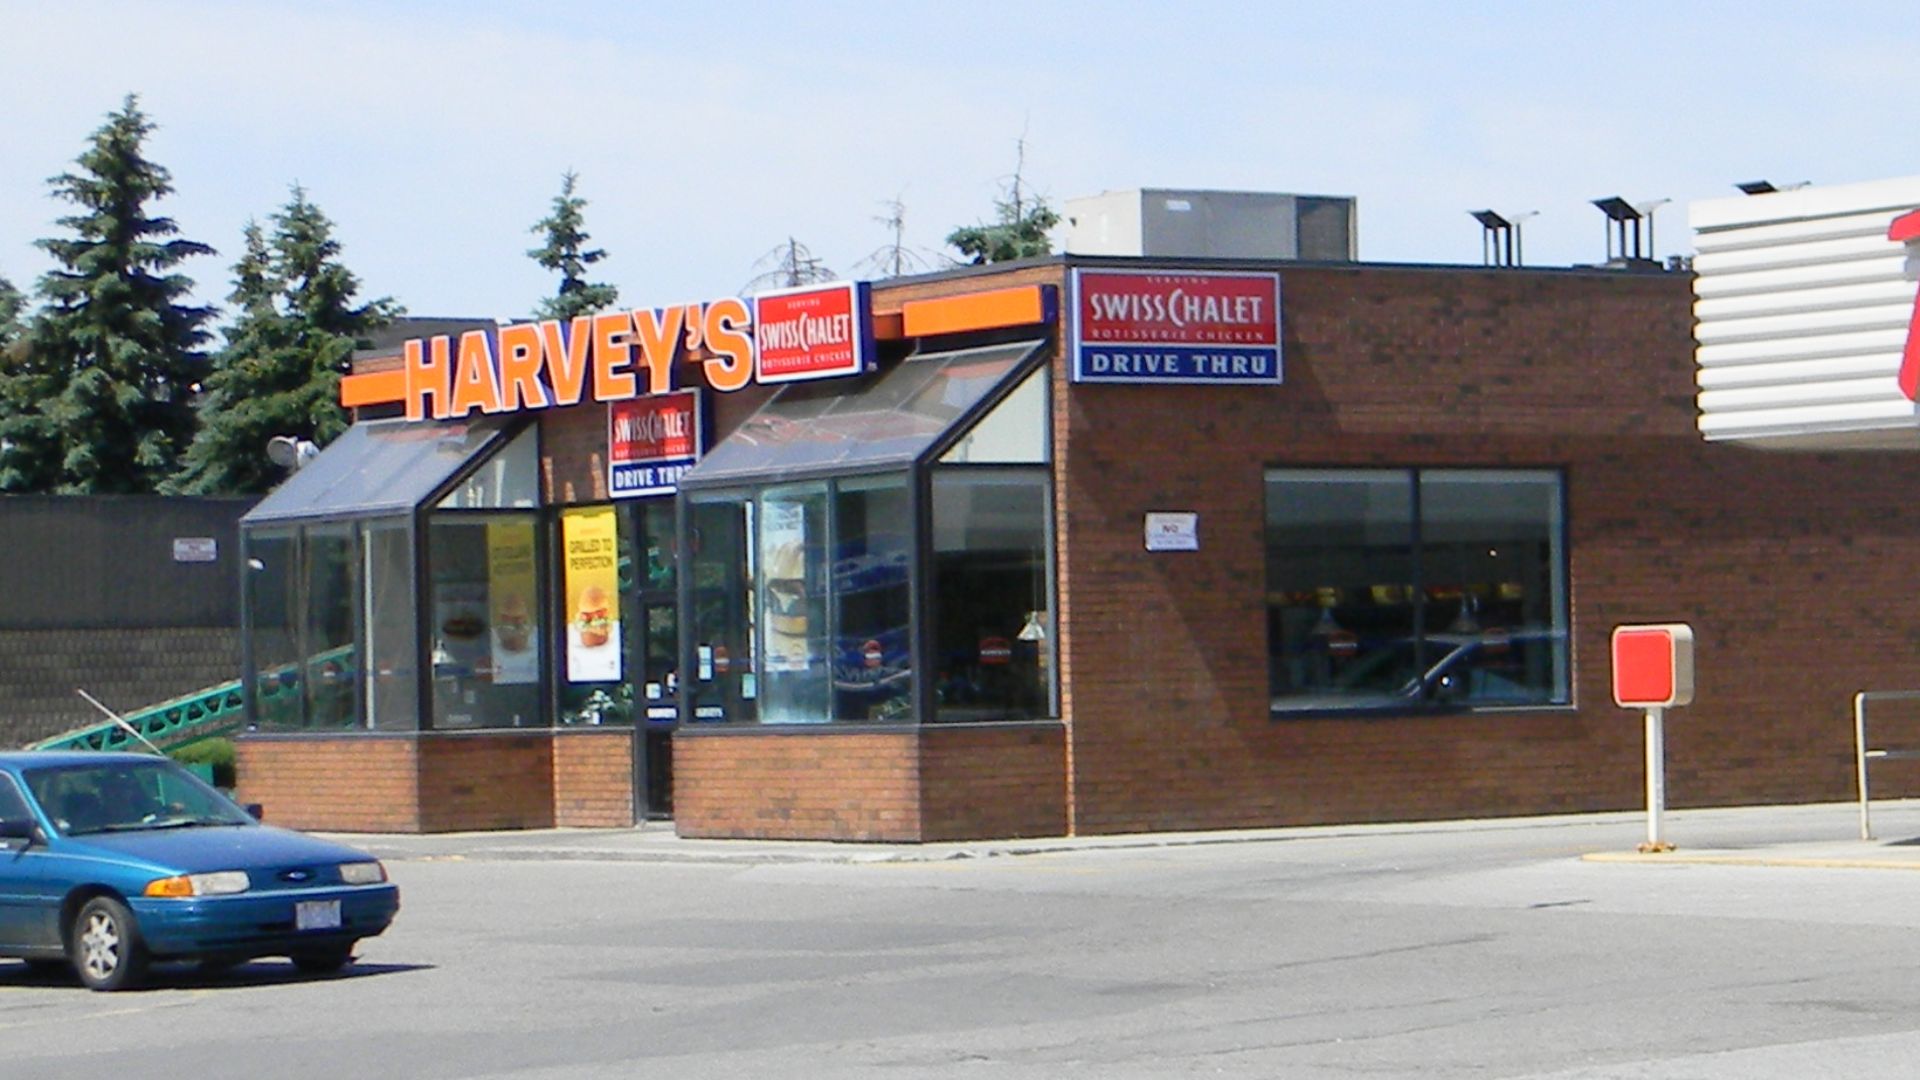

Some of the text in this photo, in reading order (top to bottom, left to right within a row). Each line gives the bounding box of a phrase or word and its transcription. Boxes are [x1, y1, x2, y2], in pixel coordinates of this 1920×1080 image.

[1091, 328, 1265, 341] ROTISSERIE CHICKEN
[404, 297, 754, 422] HARVEY'S
[1092, 353, 1268, 375] DRIVE THRU
[614, 468, 655, 488] DRIVE
